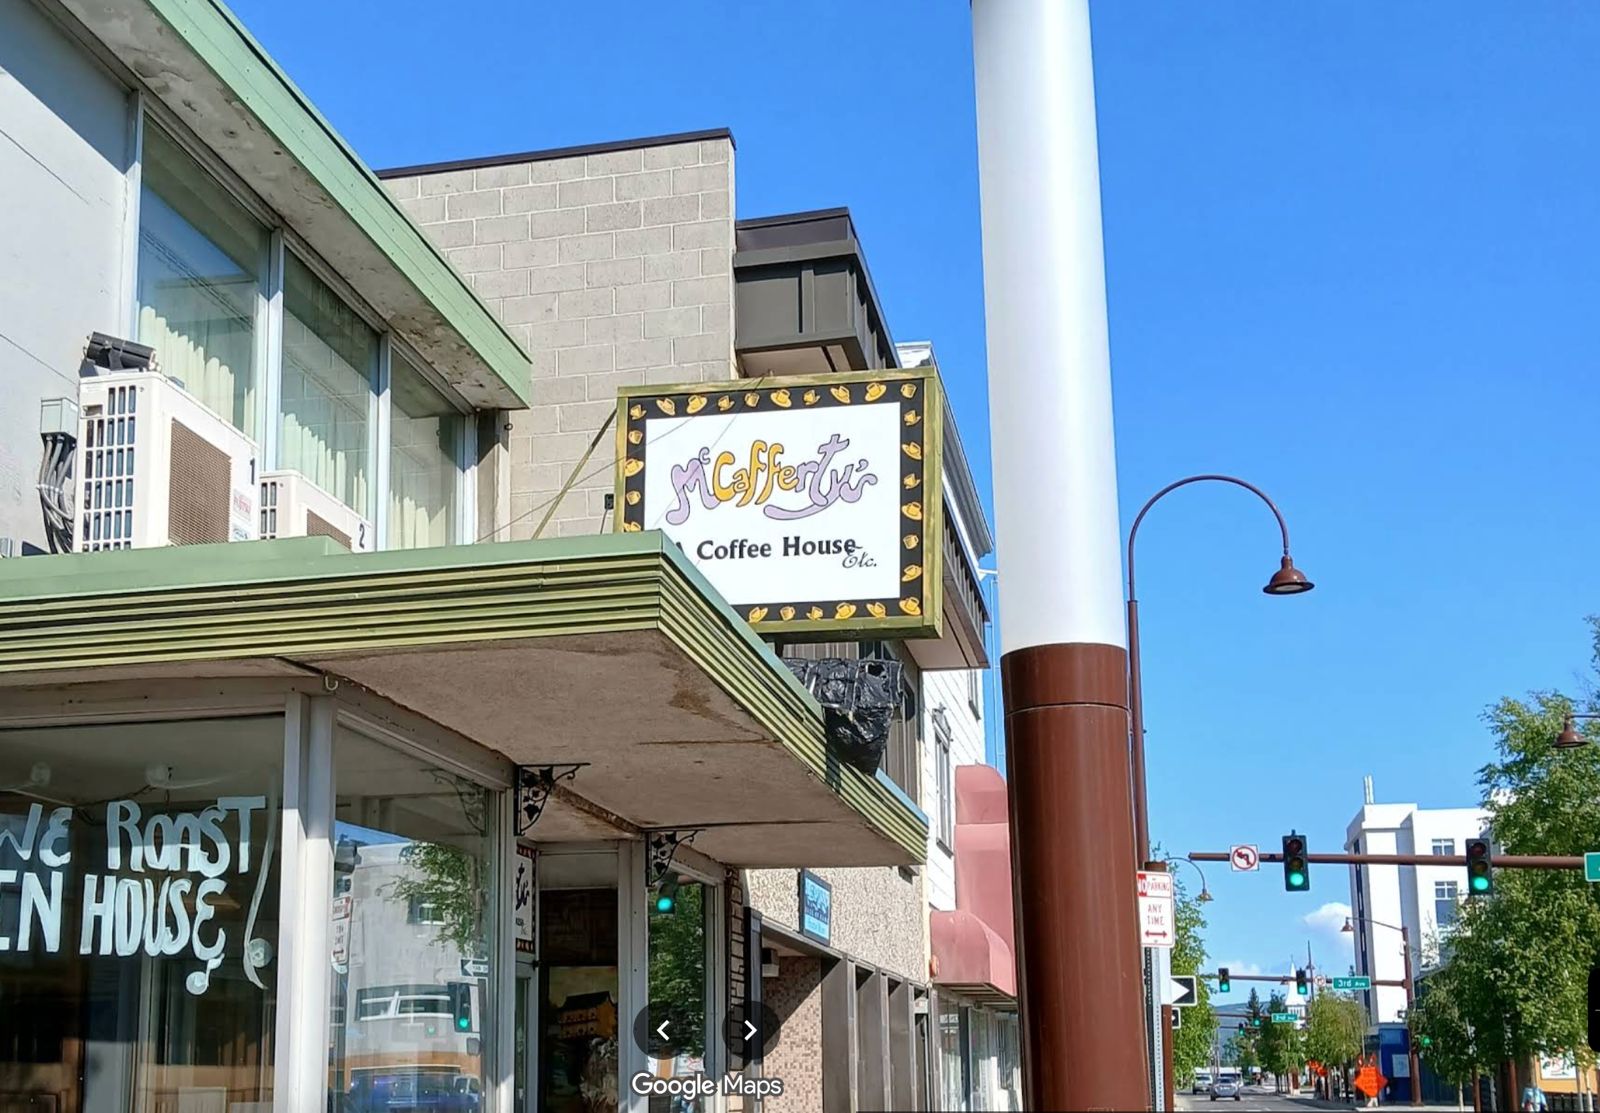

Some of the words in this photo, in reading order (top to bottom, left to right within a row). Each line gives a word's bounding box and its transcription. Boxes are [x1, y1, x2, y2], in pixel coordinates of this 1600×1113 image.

[665, 433, 878, 525] McCafferty's
[696, 538, 772, 561] Coffee
[782, 535, 856, 557] House
[842, 546, 878, 569] Etc.
[106, 795, 266, 878] ROAST
[1147, 881, 1170, 892] PARKING
[79, 874, 228, 961] HOUSE
[1148, 903, 1162, 913] ANY
[1147, 915, 1164, 926] TIME
[1338, 979, 1352, 988] 3rd
